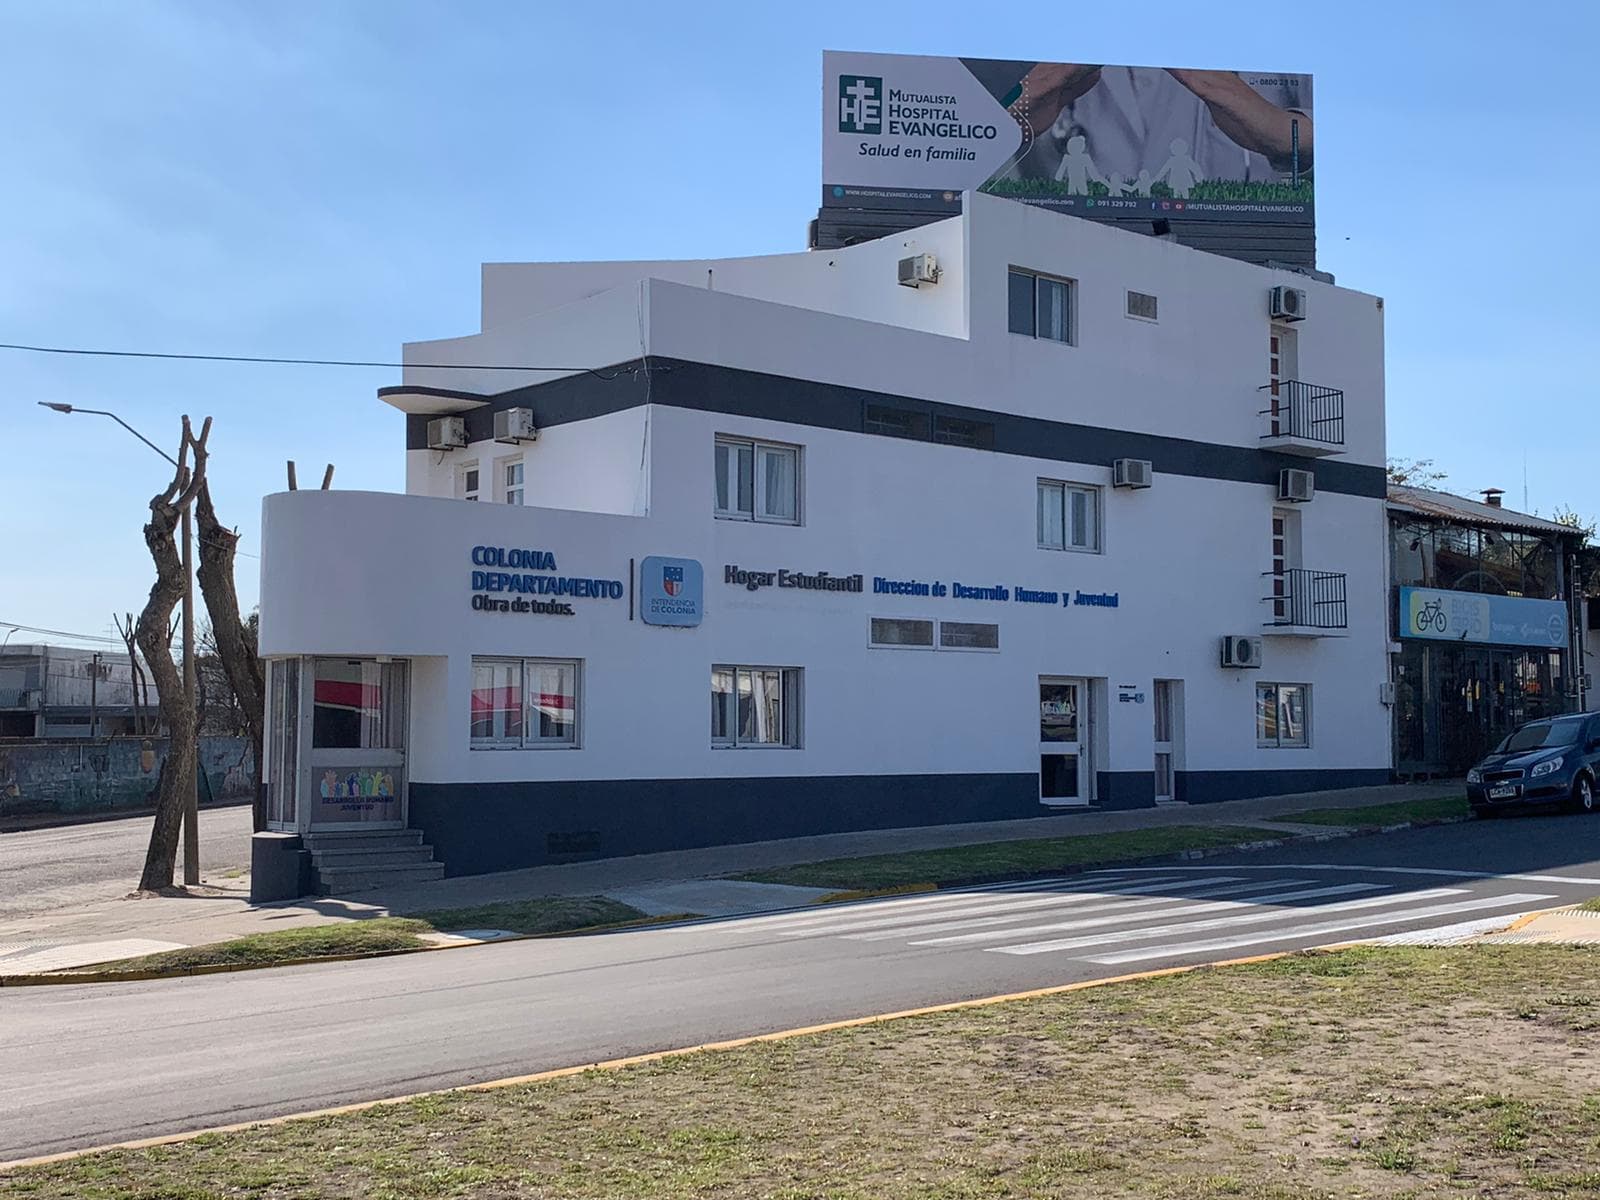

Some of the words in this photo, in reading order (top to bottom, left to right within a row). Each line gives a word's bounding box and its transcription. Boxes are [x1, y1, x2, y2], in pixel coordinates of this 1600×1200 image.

[889, 89, 957, 105] MUTUALISTA
[889, 104, 959, 121] HOSPITAL
[889, 121, 997, 140] EVANGELICO
[859, 143, 900, 157] Salud
[904, 148, 921, 158] en
[926, 146, 976, 162] familia
[471, 545, 557, 571] COLONIA
[471, 571, 624, 600] DEPARTAMENTO
[724, 565, 777, 592] Hogar
[778, 568, 864, 593] Estudiantil
[873, 576, 929, 597] Direccion
[932, 581, 947, 598] de
[952, 581, 1009, 602] Desarrollo
[1014, 586, 1058, 605] Humano
[1063, 592, 1070, 608] y
[1074, 589, 1119, 608] Juventud
[471, 594, 510, 613] Obra
[510, 597, 530, 613] de
[531, 598, 576, 616] todos.
[650, 598, 696, 608] INTENDENCIA
[650, 605, 660, 614] DE
[660, 606, 696, 615] COLONIA
